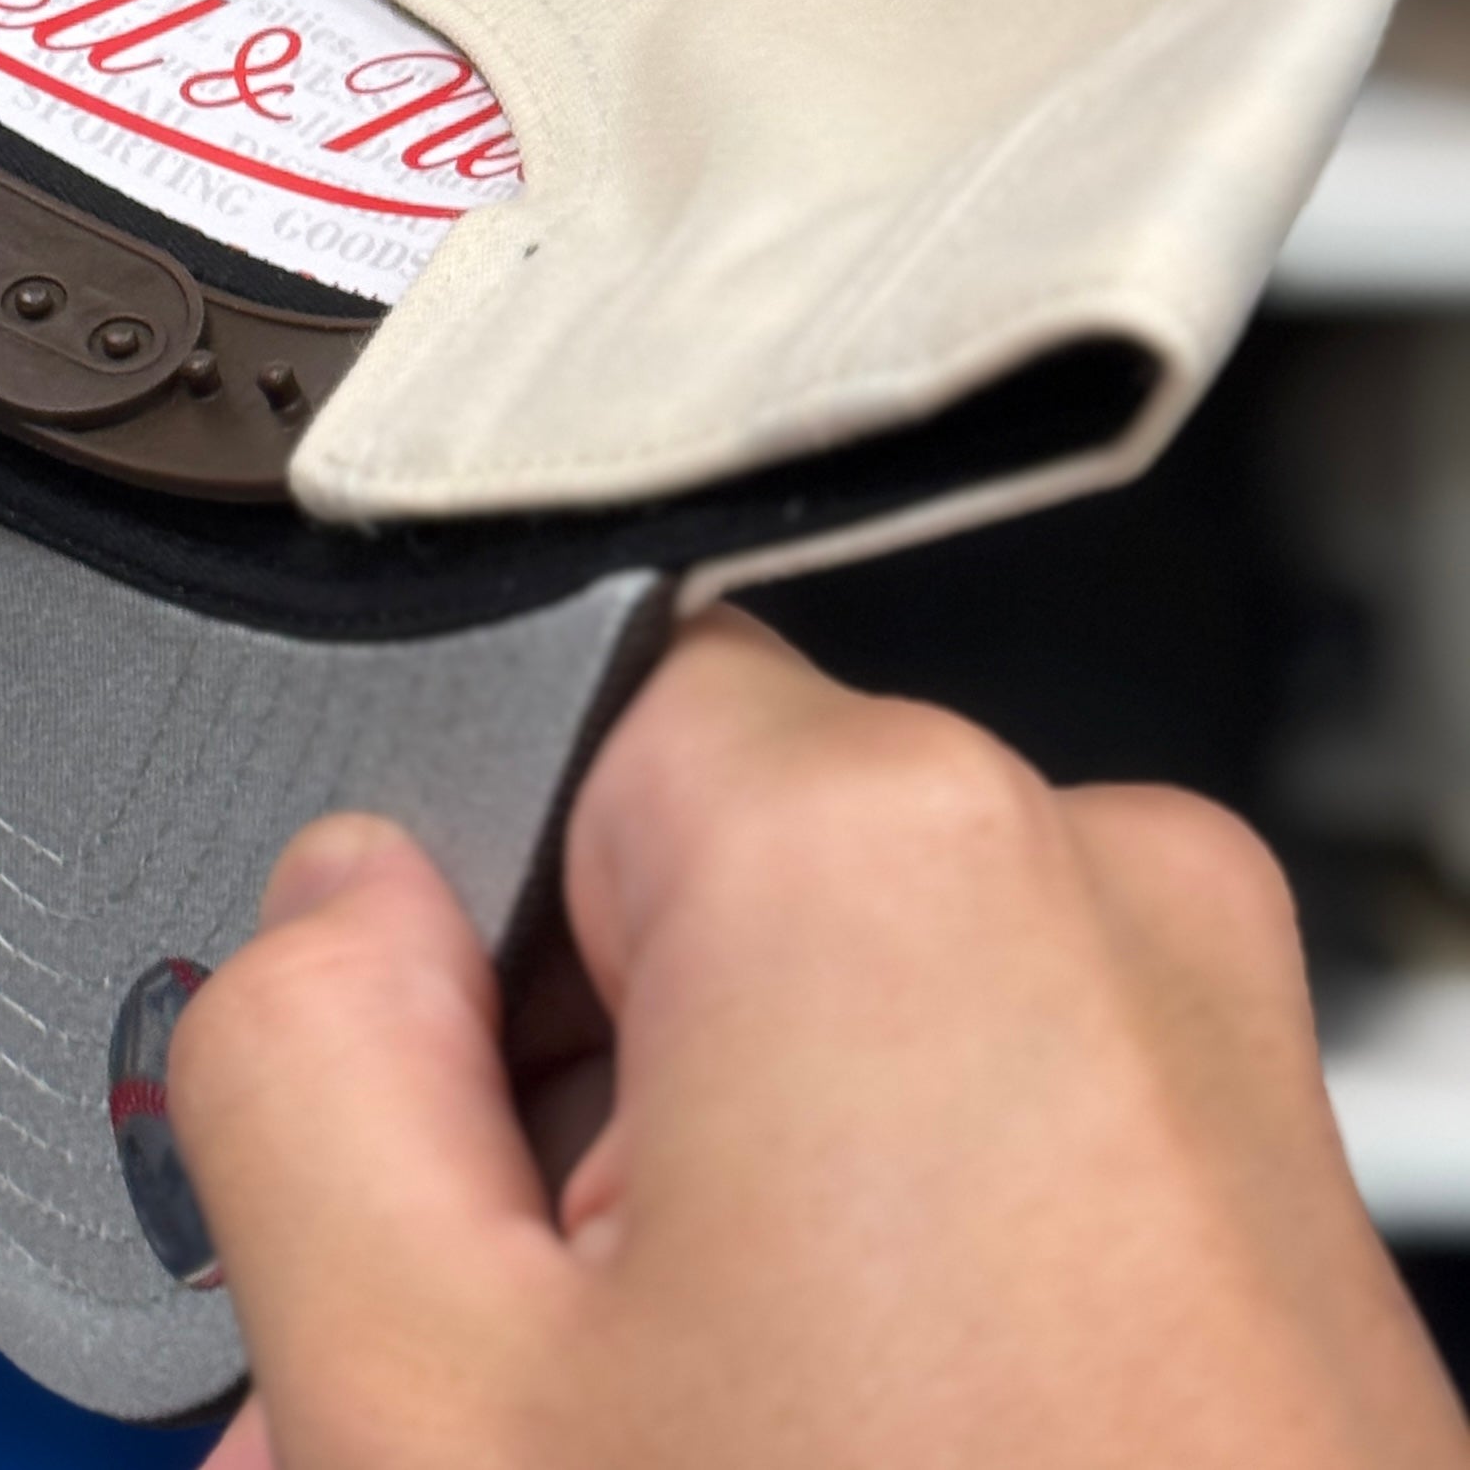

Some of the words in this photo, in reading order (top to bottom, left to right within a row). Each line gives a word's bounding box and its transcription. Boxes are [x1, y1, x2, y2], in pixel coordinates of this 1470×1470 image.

[181, 24, 300, 117] &
[320, 56, 526, 183] Ne
[272, 207, 431, 279] GOODS
